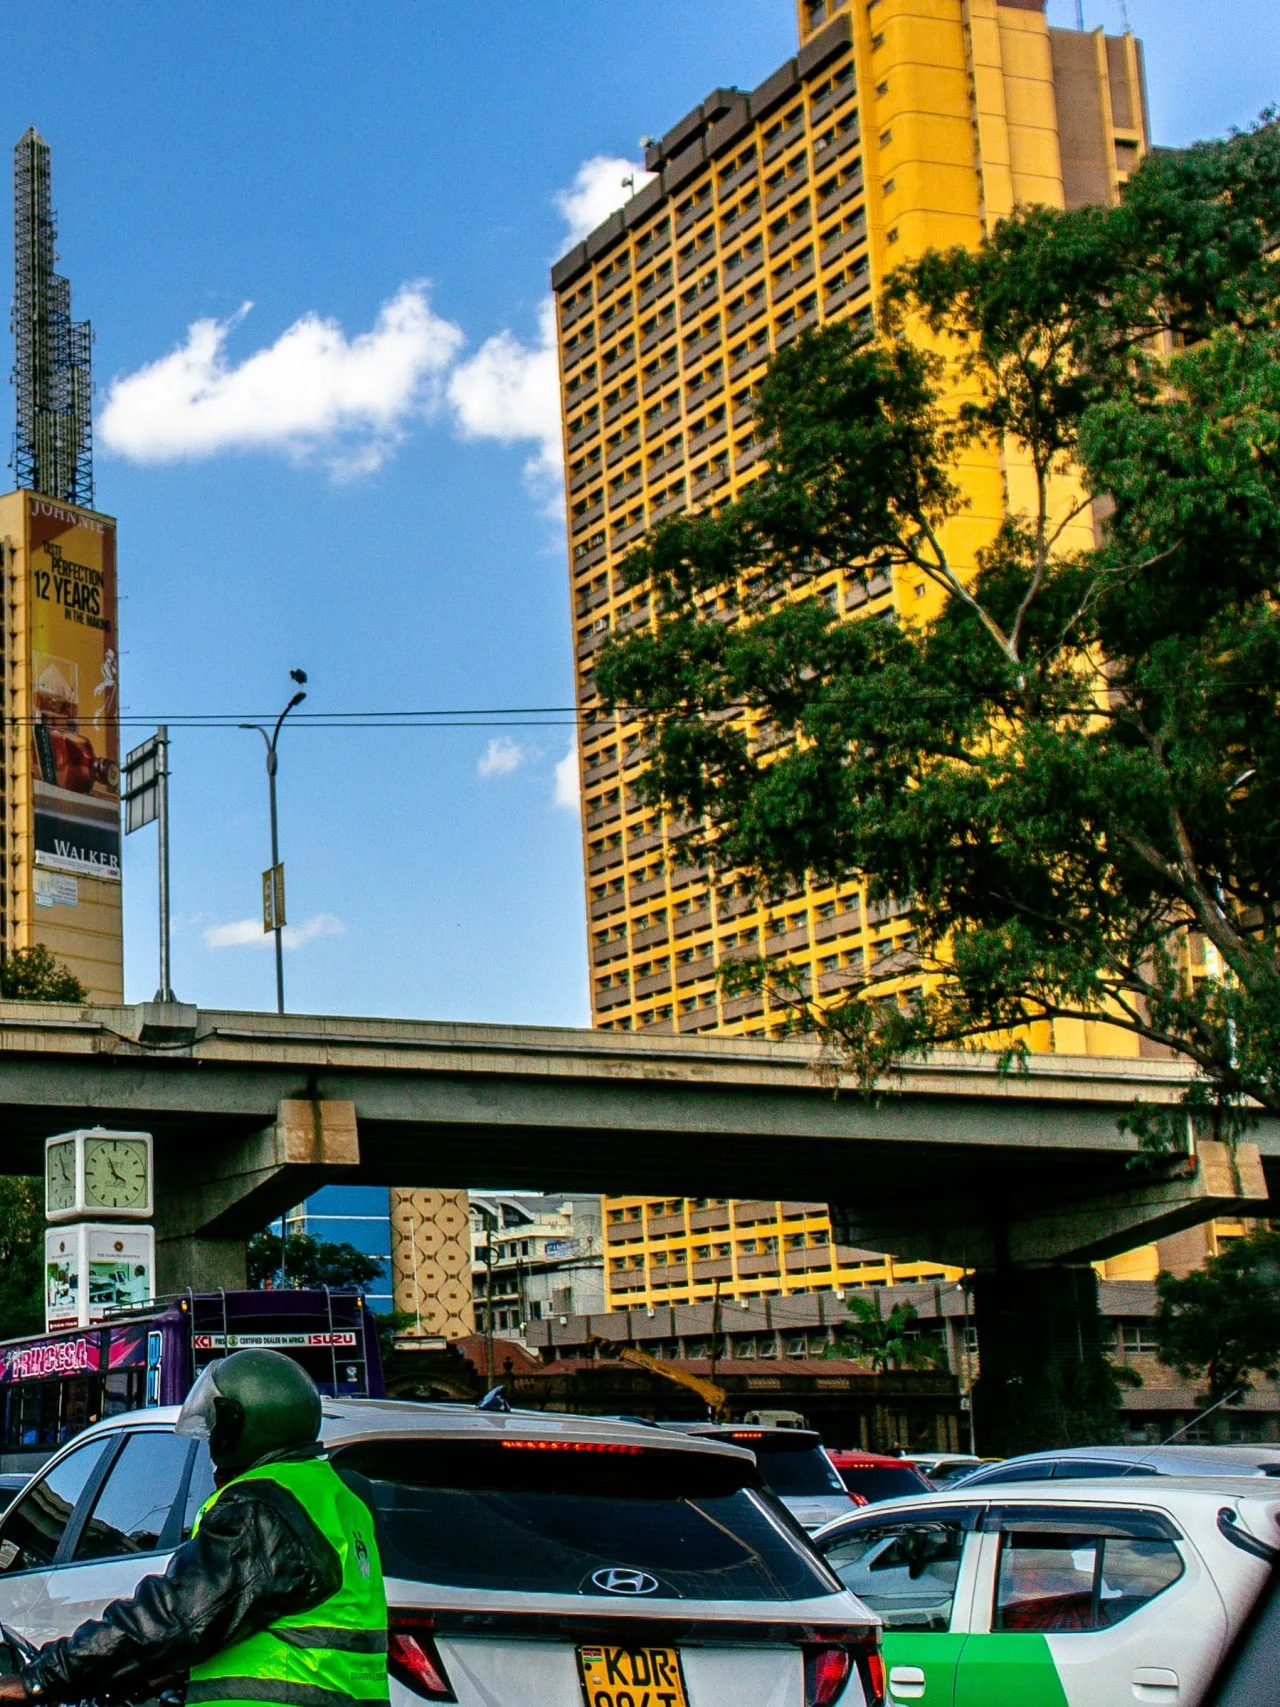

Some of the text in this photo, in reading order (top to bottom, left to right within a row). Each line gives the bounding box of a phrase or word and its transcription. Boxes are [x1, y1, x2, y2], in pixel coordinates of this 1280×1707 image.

[32, 502, 105, 533] JOHNNIE
[52, 557, 104, 588] PERFECTION
[34, 570, 100, 615] 12 YEARS
[74, 611, 84, 625] THE
[54, 839, 119, 868] WALKER
[194, 1335, 212, 1348] KCI
[308, 1333, 354, 1345] ISUZU
[12, 1338, 88, 1378] PRINCESA
[603, 1647, 674, 1687] KDR
